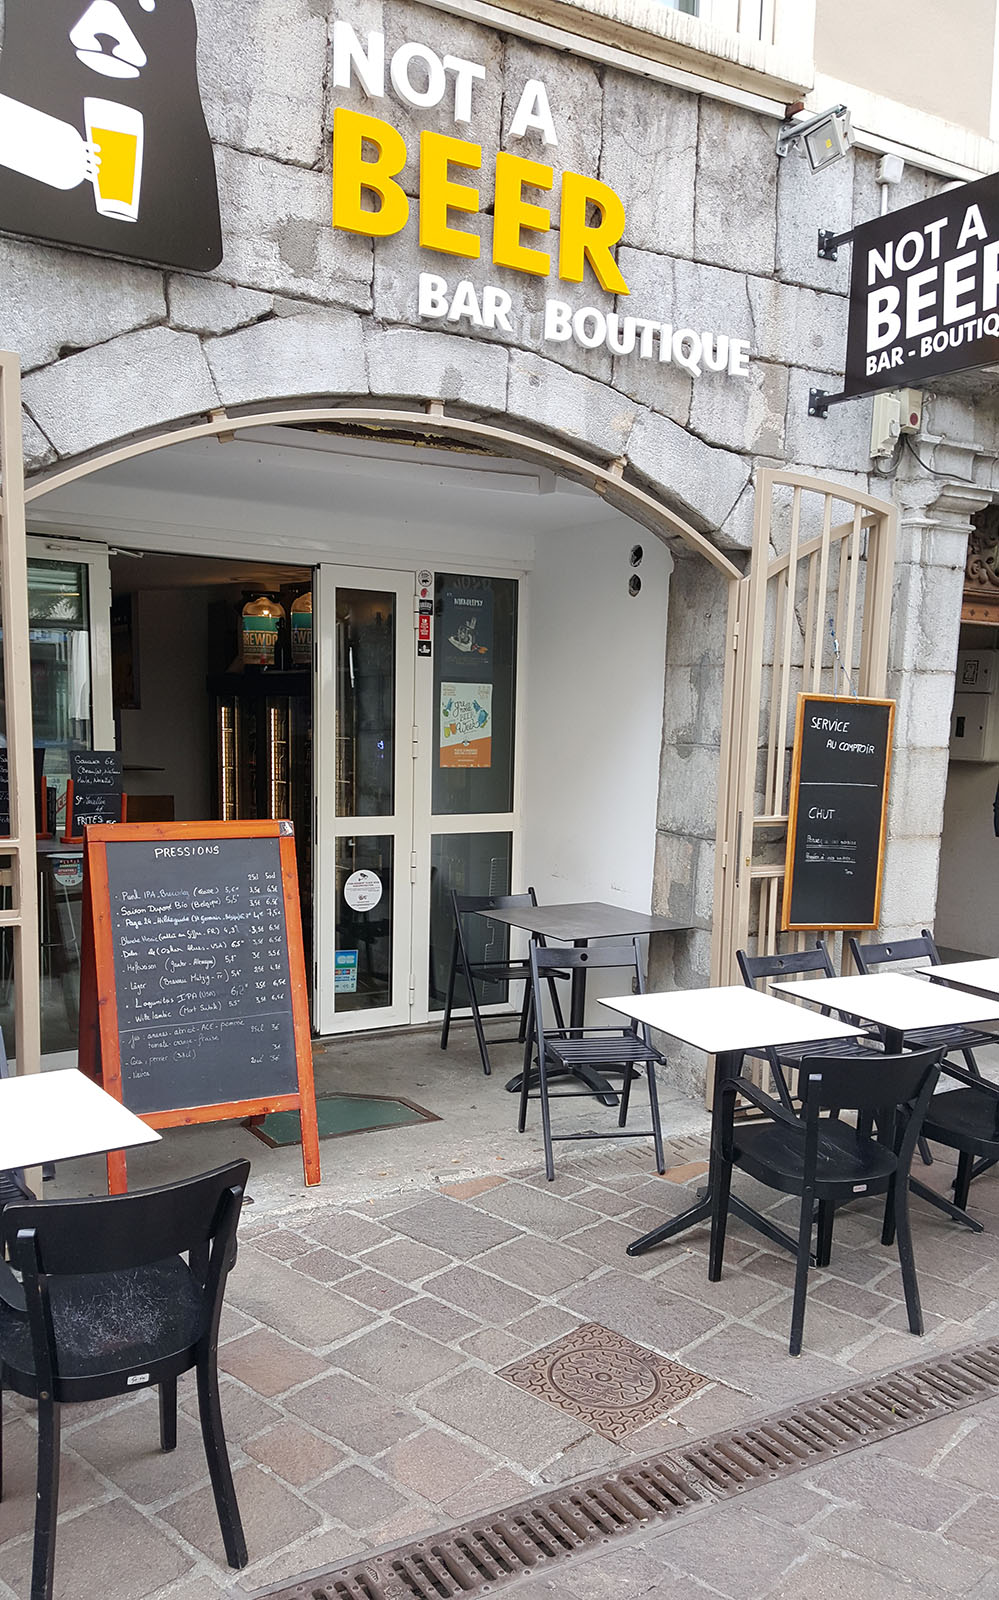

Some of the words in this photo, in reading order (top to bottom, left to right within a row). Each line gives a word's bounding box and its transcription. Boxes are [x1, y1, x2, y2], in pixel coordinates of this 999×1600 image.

[332, 20, 486, 124] NOT
[508, 79, 559, 146] A
[333, 107, 630, 296] BEER
[867, 216, 948, 286] NOT
[956, 203, 988, 250] A
[418, 272, 513, 333] BAR
[544, 300, 750, 377] BOUTIQUE
[866, 346, 905, 376] BAR
[826, 739, 837, 750] AU
[808, 807, 836, 820] CHUT
[154, 845, 220, 859] PRESSIONS
[174, 901, 188, 910] Bio
[176, 992, 197, 1003] IPA
